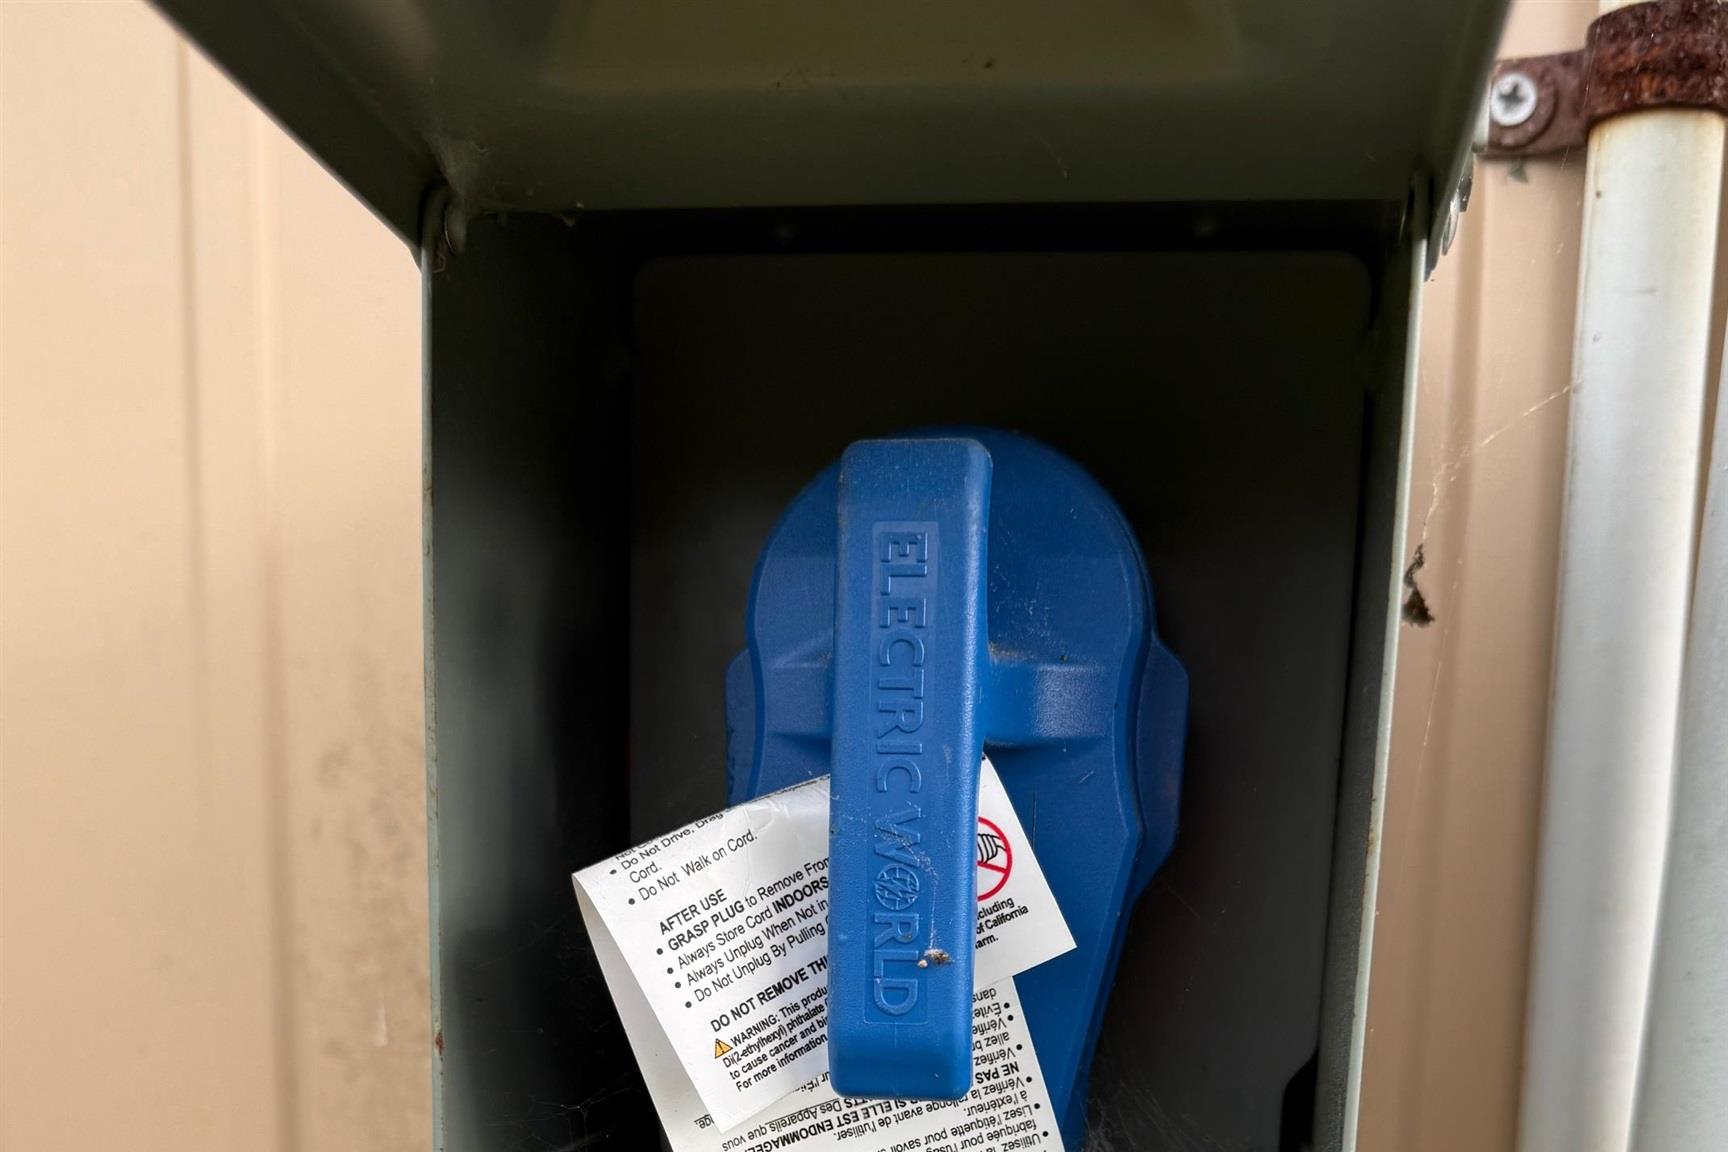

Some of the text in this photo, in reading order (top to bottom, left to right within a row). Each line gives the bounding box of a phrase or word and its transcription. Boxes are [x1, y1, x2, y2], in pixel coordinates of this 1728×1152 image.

[871, 528, 930, 1017] ELECTRIC WORLD
[621, 858, 638, 870] Do
[639, 845, 661, 859] Not
[661, 829, 695, 848] Drive,
[630, 861, 658, 883] Cord.
[638, 829, 757, 901] Do Not Walk on Cord.
[660, 888, 727, 935] AFTER USE
[668, 870, 804, 951] GRASP PLUG to Remove
[678, 876, 828, 969] Always Store Cord INDOORS
[977, 898, 1015, 924] cluding
[984, 905, 1029, 930] California
[687, 958, 724, 986] Always
[724, 936, 764, 962] Unplug
[761, 917, 796, 940] When
[794, 904, 818, 923] Not
[816, 900, 828, 911] in
[694, 922, 826, 1002] Do Not Unplug By Pulling
[710, 1014, 730, 1032] DO
[730, 997, 756, 1021] NOT
[756, 967, 809, 1005] REMOVE
[722, 1004, 825, 1068] Di(2-ethylhexyl) phthalate
[730, 1014, 781, 1047] WARNING:
[779, 1002, 801, 1018] This
[973, 1018, 1007, 1036] Vérifie
[729, 1022, 817, 1080] to cause cancer and
[984, 1031, 1010, 1047] allez
[736, 1034, 827, 1092] For more information
[973, 1047, 1016, 1066] Vérifiez
[975, 1061, 1020, 1084] NE PAS
[809, 1098, 842, 1114] Des
[833, 1076, 1025, 1141] Vérifiez la avant de l'utiliser.
[860, 1100, 893, 1120] ELLE
[963, 1090, 1027, 1116] à l'extérieur.
[1003, 1104, 1033, 1121] Lisez
[765, 1101, 829, 1132] Appareils
[837, 1110, 860, 1128] EST
[950, 1114, 1002, 1137] l'étiquette
[747, 1123, 767, 1140] que
[924, 1128, 948, 1145] pour
[961, 1132, 984, 1150] pour
[986, 1119, 1037, 1142] fabriquée
[1001, 1133, 1041, 1152] Utilisez
[722, 1136, 746, 1152] vous
